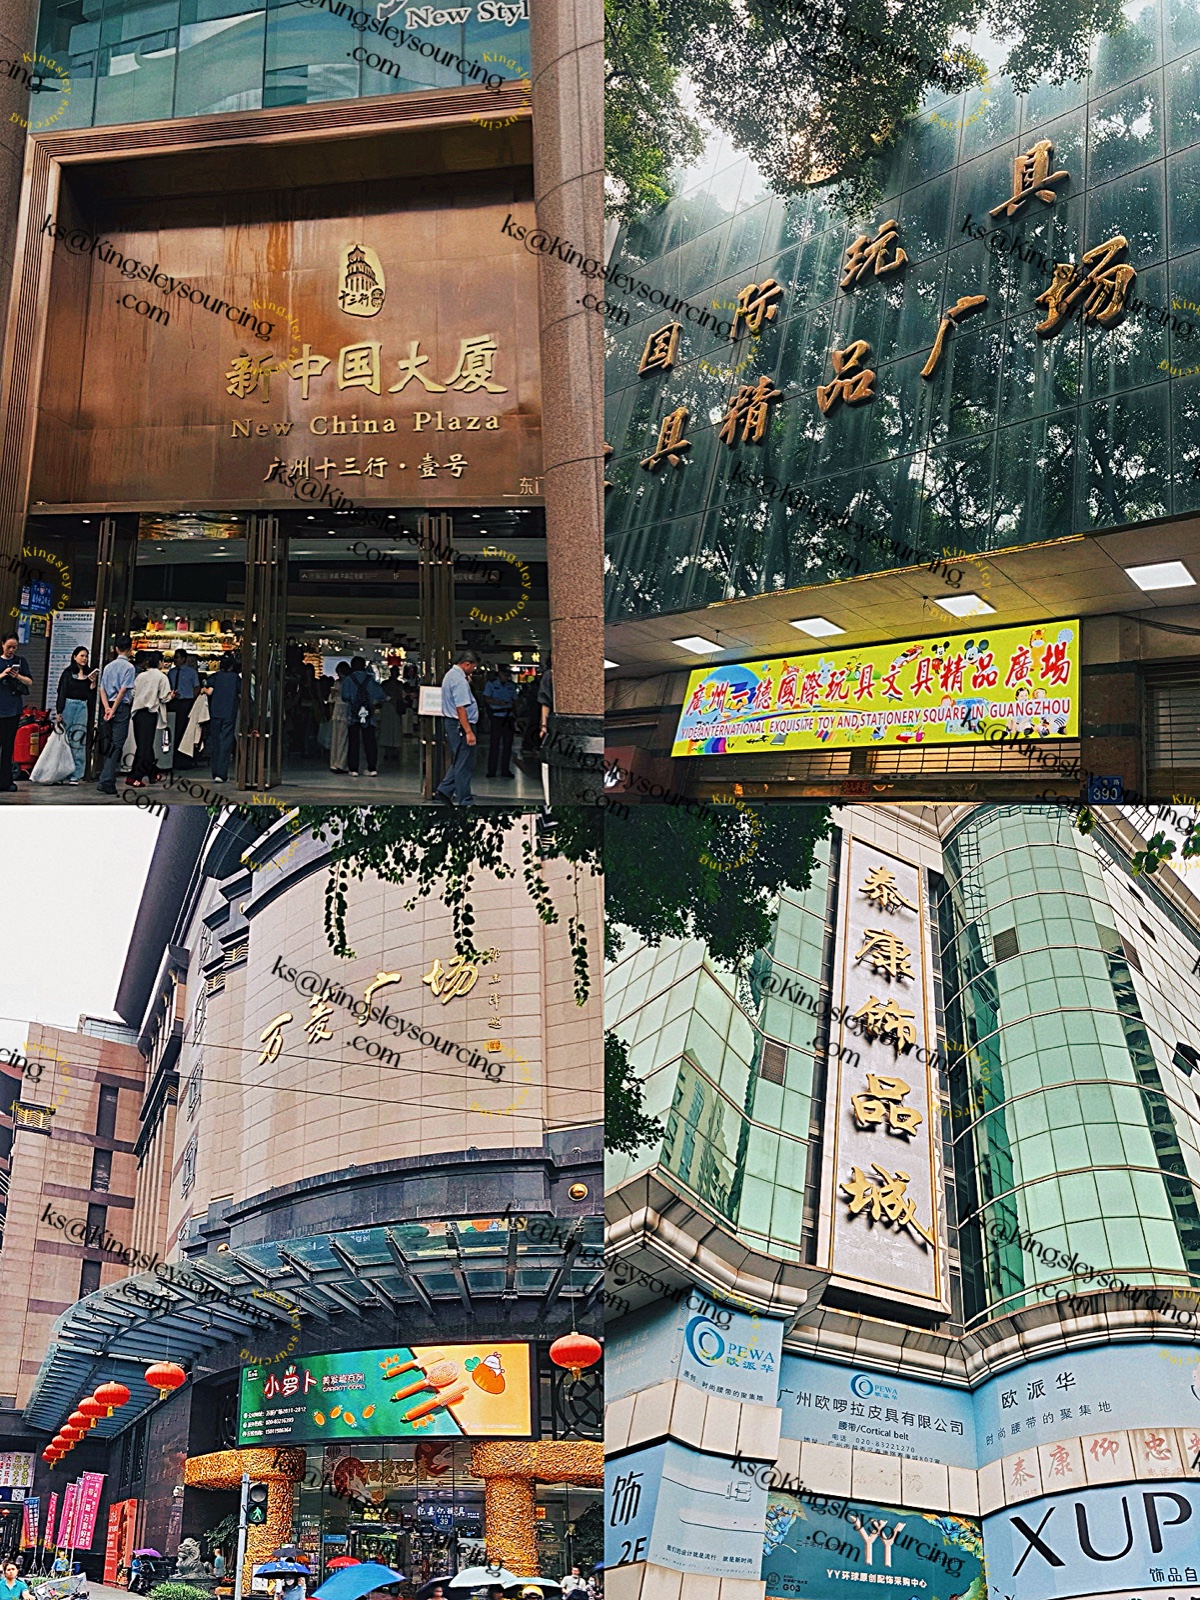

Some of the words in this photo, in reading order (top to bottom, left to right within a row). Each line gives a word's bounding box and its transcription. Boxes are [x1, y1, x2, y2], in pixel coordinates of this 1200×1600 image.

[406, 6, 471, 29] New
[225, 333, 508, 403] 新中国大厦
[231, 418, 293, 437] New
[309, 414, 397, 435] China
[413, 410, 500, 433] Plaza
[818, 716, 835, 729] TOY
[922, 708, 966, 723] SQUARE
[971, 705, 984, 719] IN
[989, 699, 1071, 719] GUANGZHOU
[1093, 787, 1118, 800] 390
[839, 866, 935, 1248] 泰康饰品城
[727, 1358, 774, 1374] 欧派华
[1001, 1372, 1076, 1409] 欧派华
[893, 1429, 910, 1441] belt
[986, 1401, 1112, 1446] 时尚腰带的聚集地
[439, 1518, 449, 1526] 39
[1009, 1492, 1192, 1577] XUP
[618, 1536, 647, 1566] 2F
[782, 1583, 801, 1592] G03
